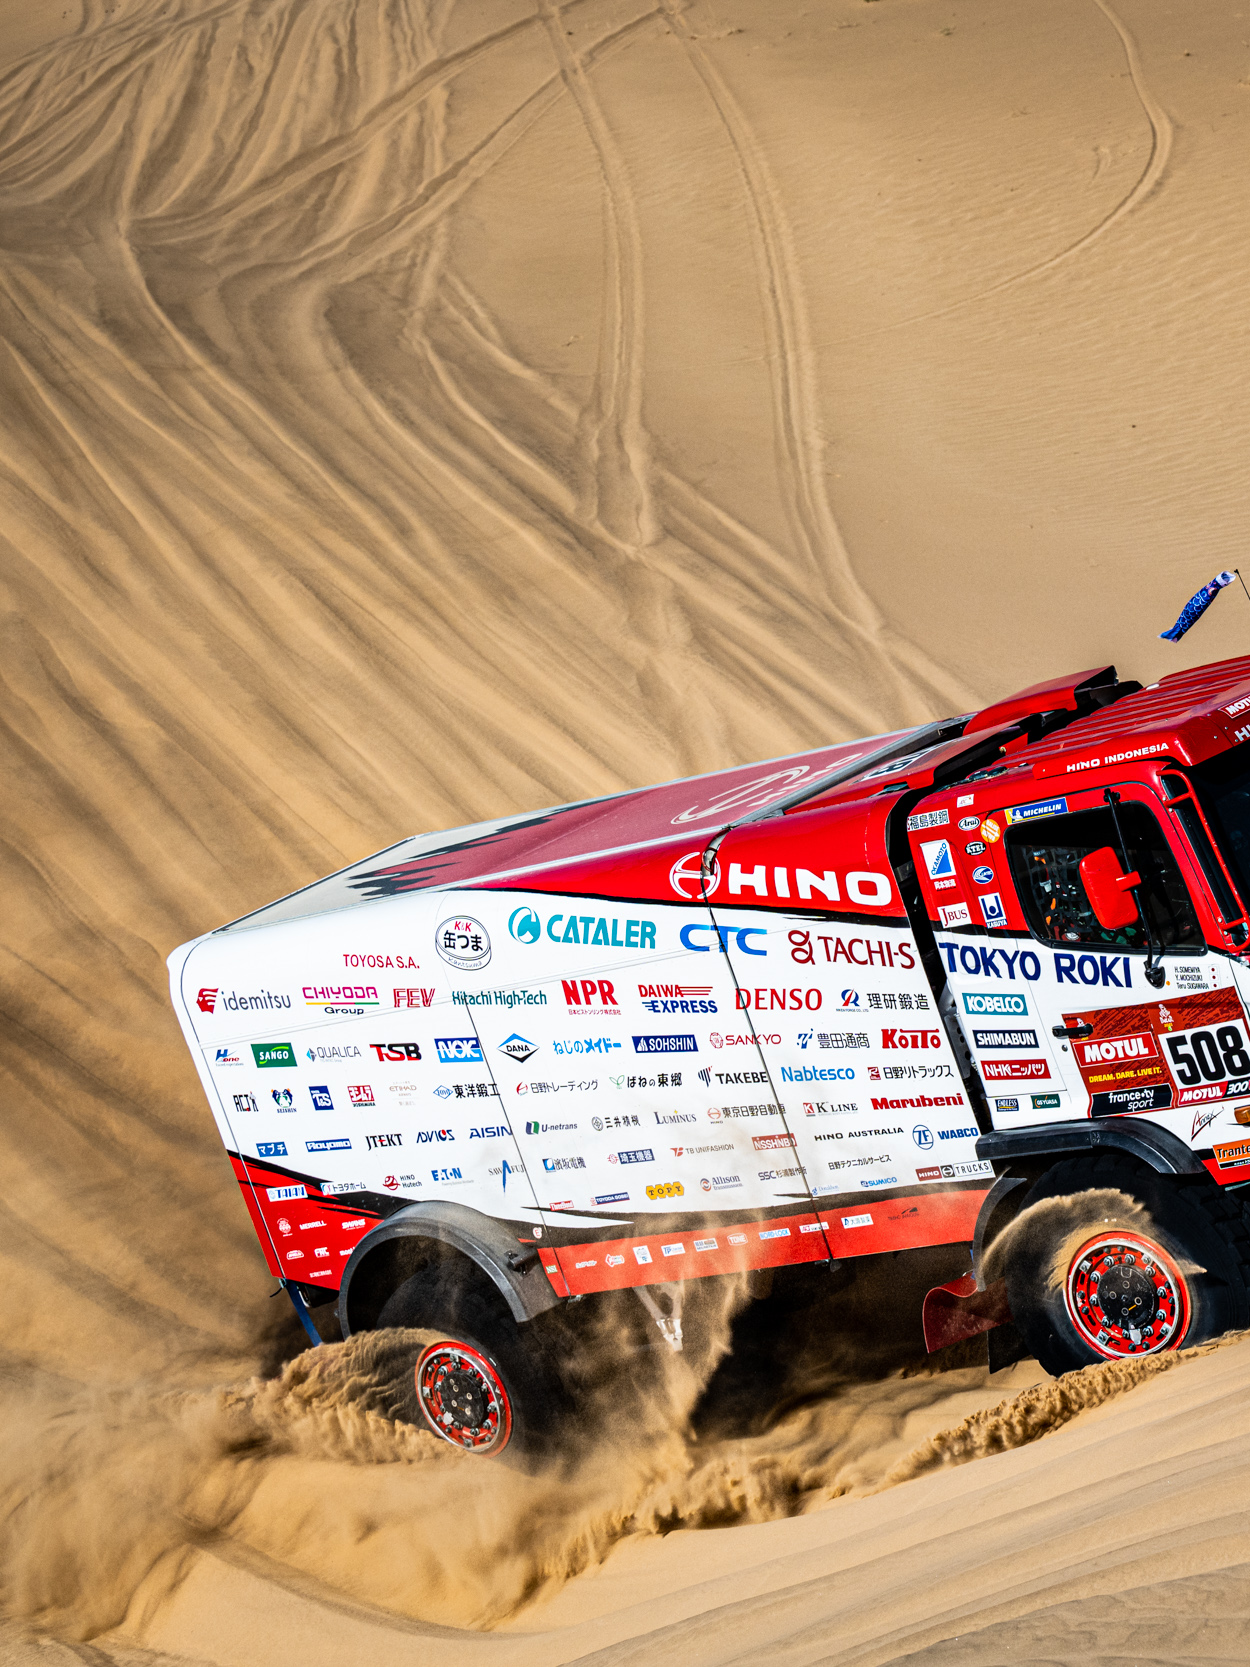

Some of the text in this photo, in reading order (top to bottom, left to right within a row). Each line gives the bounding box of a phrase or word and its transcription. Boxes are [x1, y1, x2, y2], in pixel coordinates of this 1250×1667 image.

[1066, 742, 1169, 772] HINO INDONESIA
[1023, 804, 1062, 817] MICHELIN
[931, 842, 947, 875] OKAMOTO
[728, 862, 892, 906] HINO
[943, 909, 968, 926] JBUS
[546, 914, 657, 949] CATALER
[443, 930, 484, 952] 缶つま
[680, 924, 768, 956] CTC
[817, 935, 916, 970] TACHI-S
[343, 954, 420, 970] TOYOSA S.A.
[938, 942, 1132, 988] TOKYO ROKI
[302, 986, 378, 1000] CHIYODA
[561, 980, 619, 1006] NPR
[638, 984, 684, 998] DAIWA
[1177, 982, 1210, 990] Teru SUGAWARA
[222, 988, 292, 1012] idemitsu
[392, 988, 436, 1008] FEV
[452, 990, 547, 1009] Hitachi High-Tech
[735, 988, 822, 1011] DENSO
[866, 992, 930, 1011] 理研鍛造
[966, 995, 1024, 1012] KOBELCO
[324, 1005, 364, 1015] Group
[652, 1000, 718, 1014] EXPRESS
[552, 1037, 622, 1056] ねじのメイドー
[650, 1036, 694, 1052] SOHSHIN
[726, 1034, 782, 1046] SANKYO
[817, 1032, 870, 1050] 豊田通商
[976, 1032, 1036, 1046] SHIMABUN
[260, 1050, 289, 1060] SANGO
[316, 1046, 362, 1059] QUALICA
[369, 1043, 422, 1062] TSB
[437, 1040, 481, 1058] NOK
[506, 1044, 530, 1052] DANA
[1084, 1038, 1149, 1063] MOTUL
[715, 1071, 768, 1084] TAKEBE
[780, 1066, 855, 1082] Nabtesco
[883, 1064, 954, 1080] 日野リトラックス
[1088, 1066, 1162, 1083] DREAM. DARE. LIVE IT.
[452, 1084, 500, 1098] 東洋鍛工
[530, 1080, 599, 1094] 日野トレーディング
[1181, 1086, 1222, 1102] MOTUL
[832, 1102, 858, 1112] LINE
[870, 1093, 964, 1110] Marubeni
[997, 1099, 1018, 1108] ENDLESS
[1128, 1099, 1154, 1112] sport
[468, 1126, 514, 1140] AISIN
[541, 1122, 578, 1132] U-netrans
[814, 1128, 904, 1142] HINO AUSTRALIA
[938, 1127, 979, 1140] WABCO
[365, 1133, 403, 1151] JTEKT
[416, 1128, 456, 1144] ADVICS
[915, 1130, 932, 1146] ZF
[258, 1143, 286, 1156] マブチ
[695, 1144, 735, 1154] UNIFASHION
[828, 1154, 892, 1170] 日野テクニカルサービス
[919, 1162, 990, 1178] HINO TRUCKS
[712, 1174, 740, 1186] Allison
[758, 1170, 776, 1182] SSC
[868, 1176, 898, 1188] SUMICO
[275, 1186, 305, 1198] TAIAN
[648, 1186, 682, 1197] TOPY
